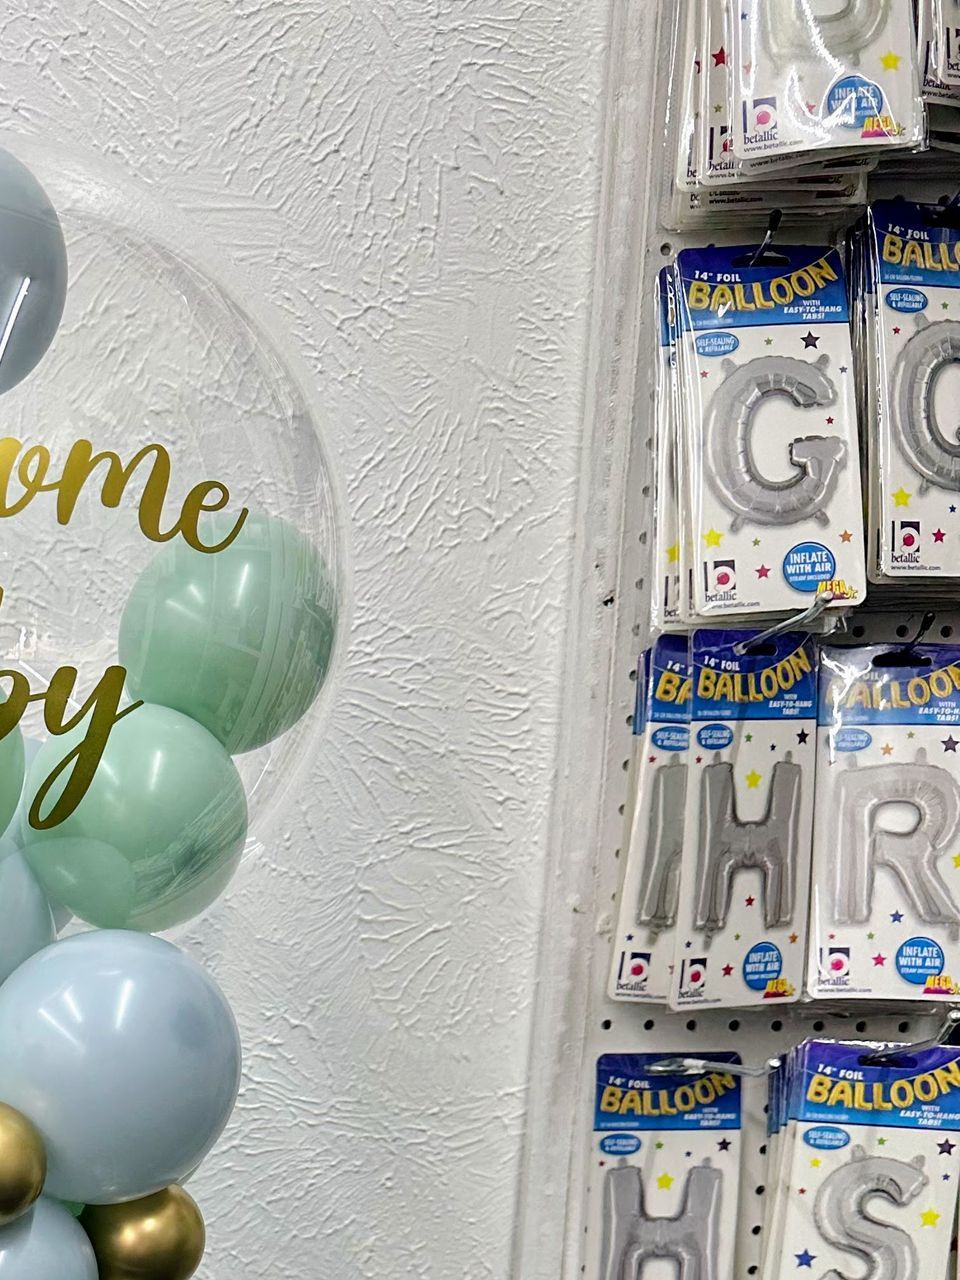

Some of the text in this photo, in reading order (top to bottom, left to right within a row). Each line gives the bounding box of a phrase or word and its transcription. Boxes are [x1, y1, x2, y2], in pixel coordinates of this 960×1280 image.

[743, 131, 778, 145] betallic
[906, 229, 930, 241] FOIL
[716, 272, 741, 282] FOIL
[688, 257, 838, 311] BALLOON
[783, 305, 842, 314] EASY-TO-HANG
[802, 312, 825, 320] TABS!
[790, 551, 828, 564] INFLATE
[891, 552, 921, 563] betallic
[786, 562, 832, 574] WITH AIR
[705, 588, 737, 603] betallic
[721, 659, 740, 671] FOIL
[697, 646, 812, 703] BALLOON
[936, 714, 959, 722] TABS!
[748, 950, 778, 963] INFLATE
[902, 946, 938, 958] INFLATE
[745, 961, 780, 973] WITH AIR
[899, 957, 941, 967] WITH AIR
[818, 976, 849, 986] betallic
[839, 1069, 865, 1081] FOIL
[628, 1080, 651, 1089] FOIL
[807, 1061, 960, 1111] BALLOON
[600, 1072, 737, 1117] BALLOON
[921, 1104, 941, 1112] WITH
[900, 1110, 960, 1120] EASY-TO-HANG
[917, 1118, 942, 1127] TABS!
